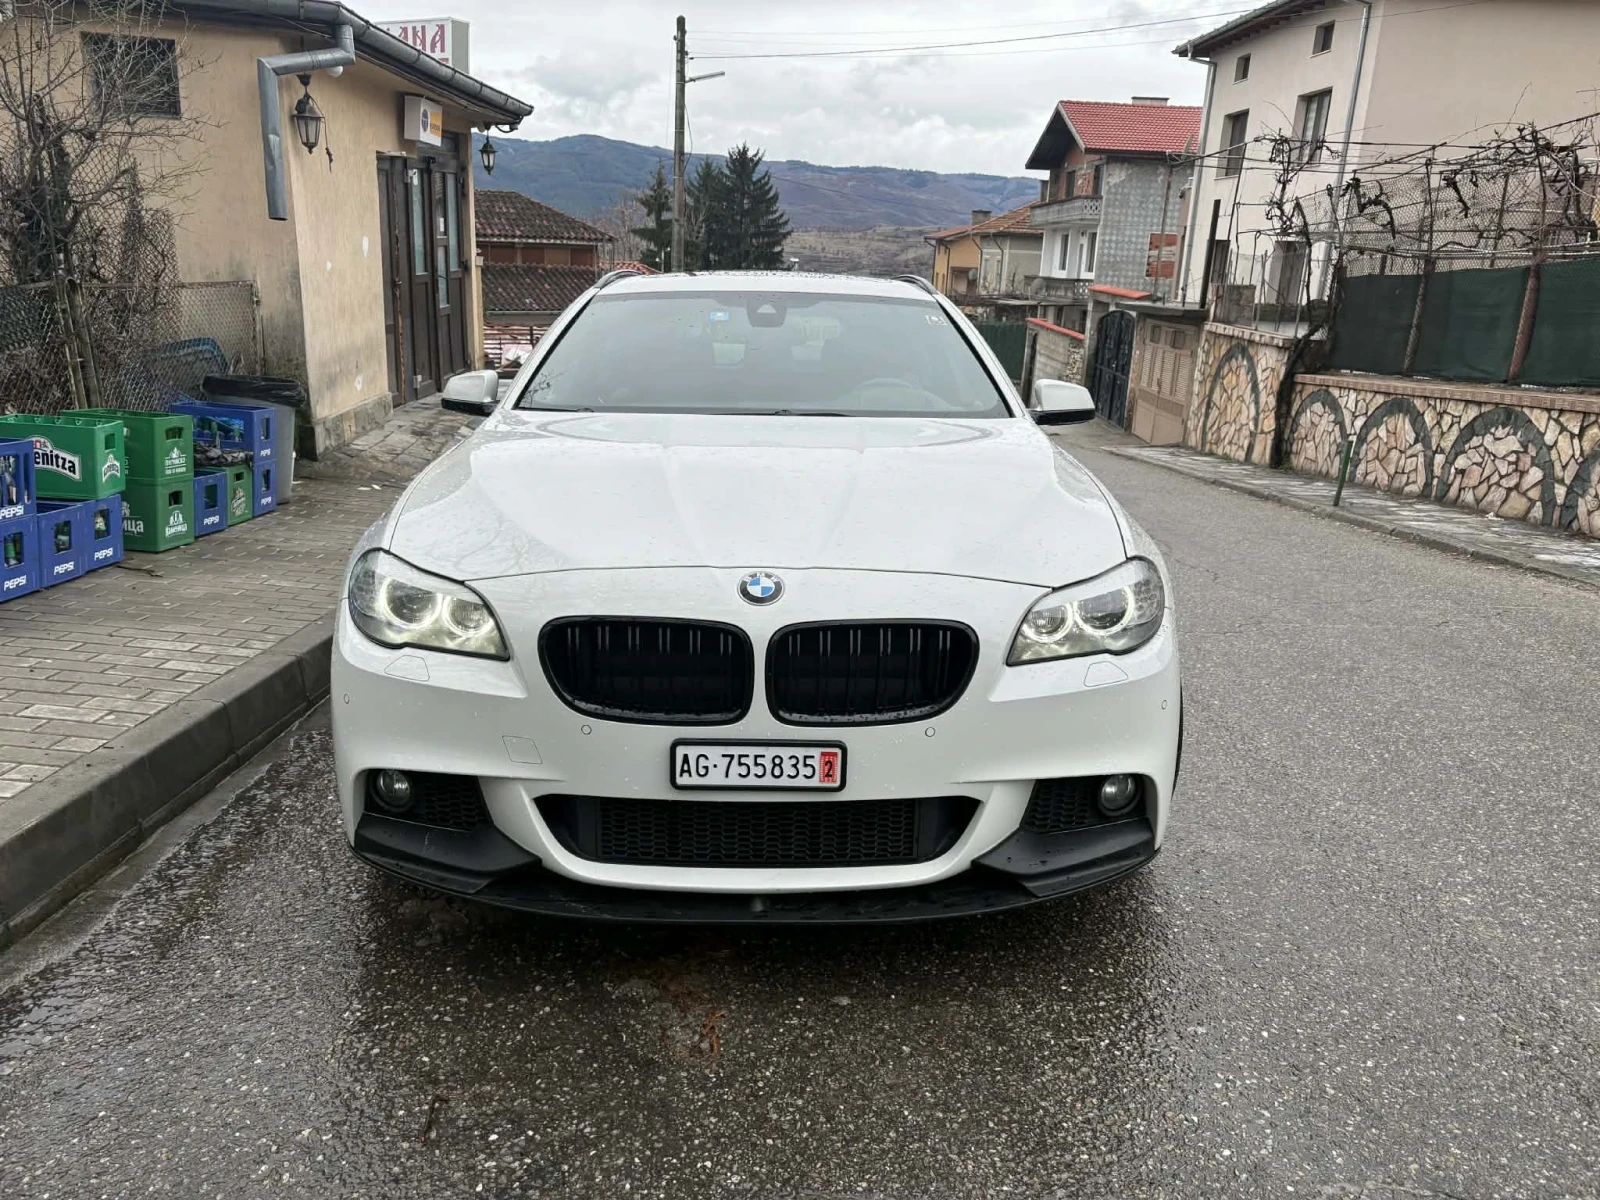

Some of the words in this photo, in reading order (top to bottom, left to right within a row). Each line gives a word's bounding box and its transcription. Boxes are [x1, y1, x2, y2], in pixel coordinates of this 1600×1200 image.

[386, 23, 446, 54] АНА
[33, 449, 77, 476] enitza
[0, 504, 24, 520] PEPSI
[203, 515, 220, 526] PEPSI
[94, 547, 114, 561] PEPSI
[53, 561, 75, 576] PEPSI
[3, 575, 27, 592] PEPSI
